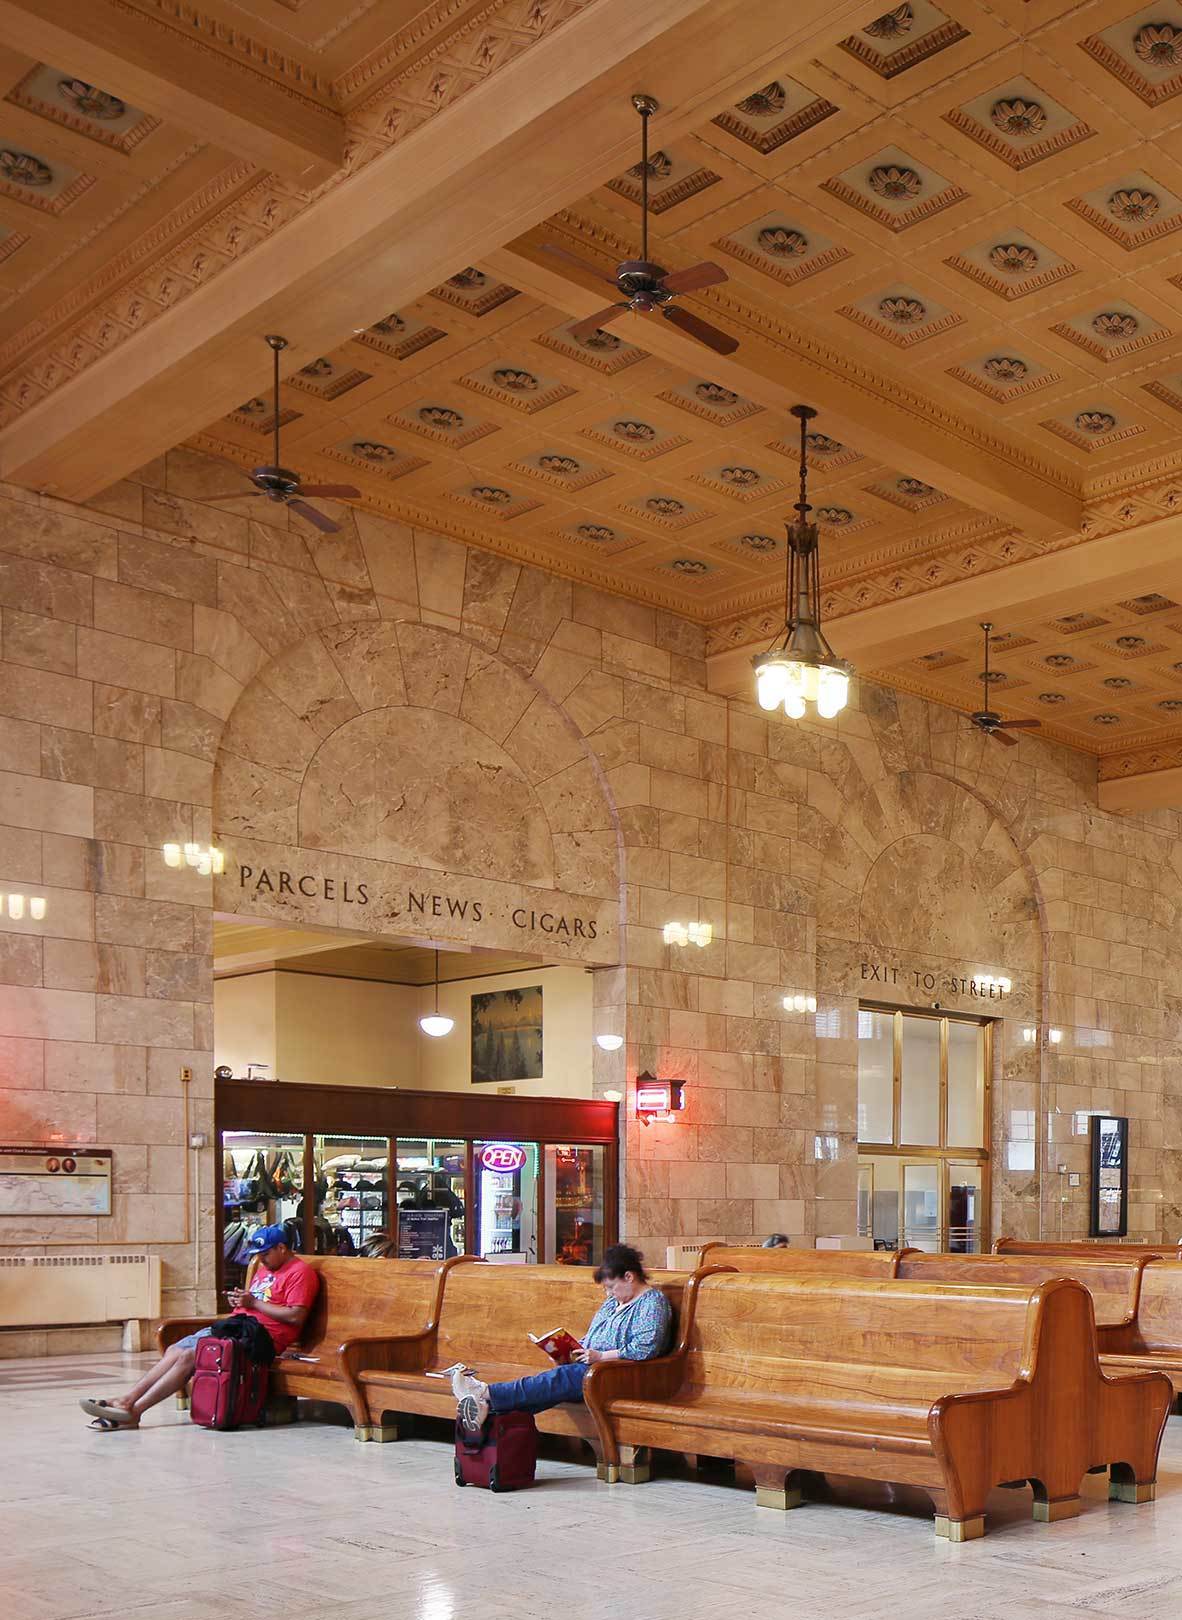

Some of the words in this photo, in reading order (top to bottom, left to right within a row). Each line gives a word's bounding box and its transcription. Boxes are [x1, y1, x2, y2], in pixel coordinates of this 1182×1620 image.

[240, 864, 370, 906] PARCELS
[408, 891, 484, 923] NEWS
[512, 908, 599, 940] CIGARS
[860, 963, 899, 985] EXIT
[913, 971, 936, 990] TO
[951, 977, 1004, 1000] STREET
[482, 1149, 523, 1167] OPEN
